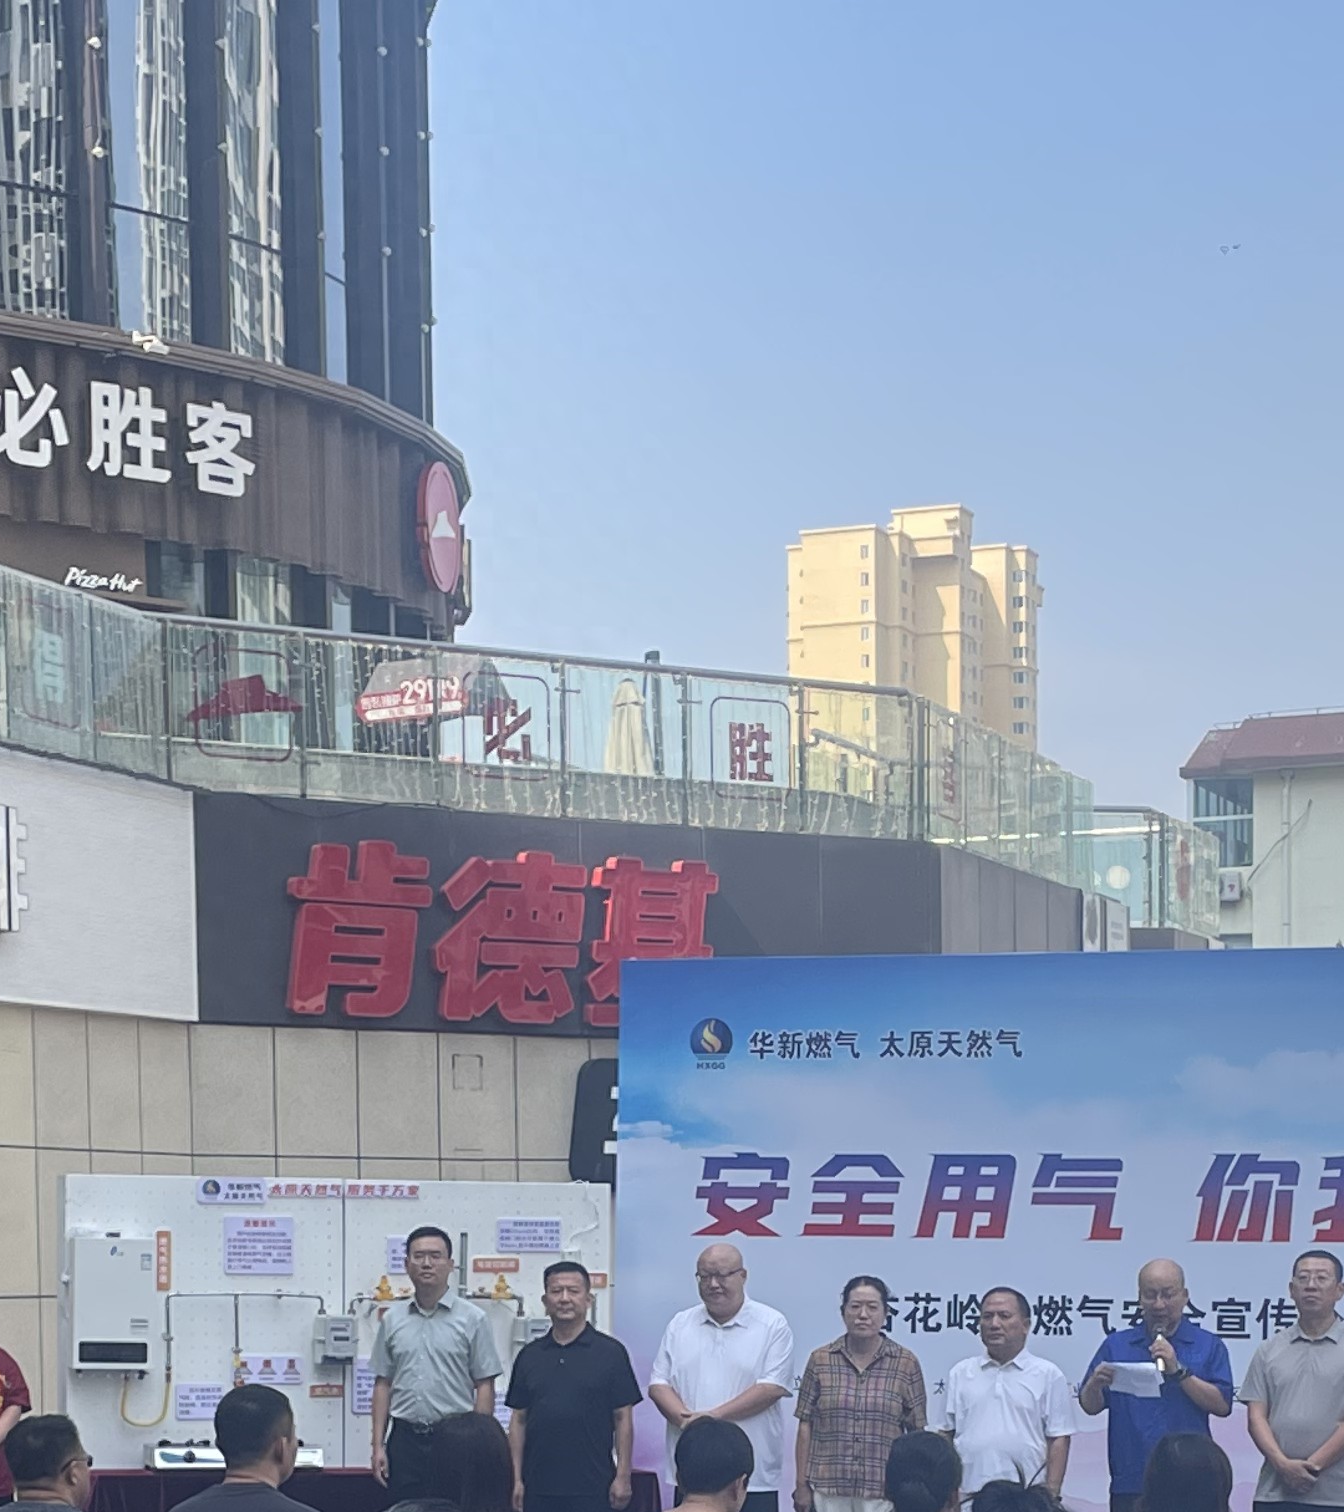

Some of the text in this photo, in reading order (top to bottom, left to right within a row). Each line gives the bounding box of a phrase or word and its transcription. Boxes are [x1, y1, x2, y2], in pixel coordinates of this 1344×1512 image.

[64, 566, 143, 593] Pizza Hut
[729, 721, 773, 782] 胜
[286, 839, 719, 1028] 肯德基
[749, 1029, 1024, 1059] 华新燃气 太原天然气
[691, 1151, 1126, 1242] 安全用气
